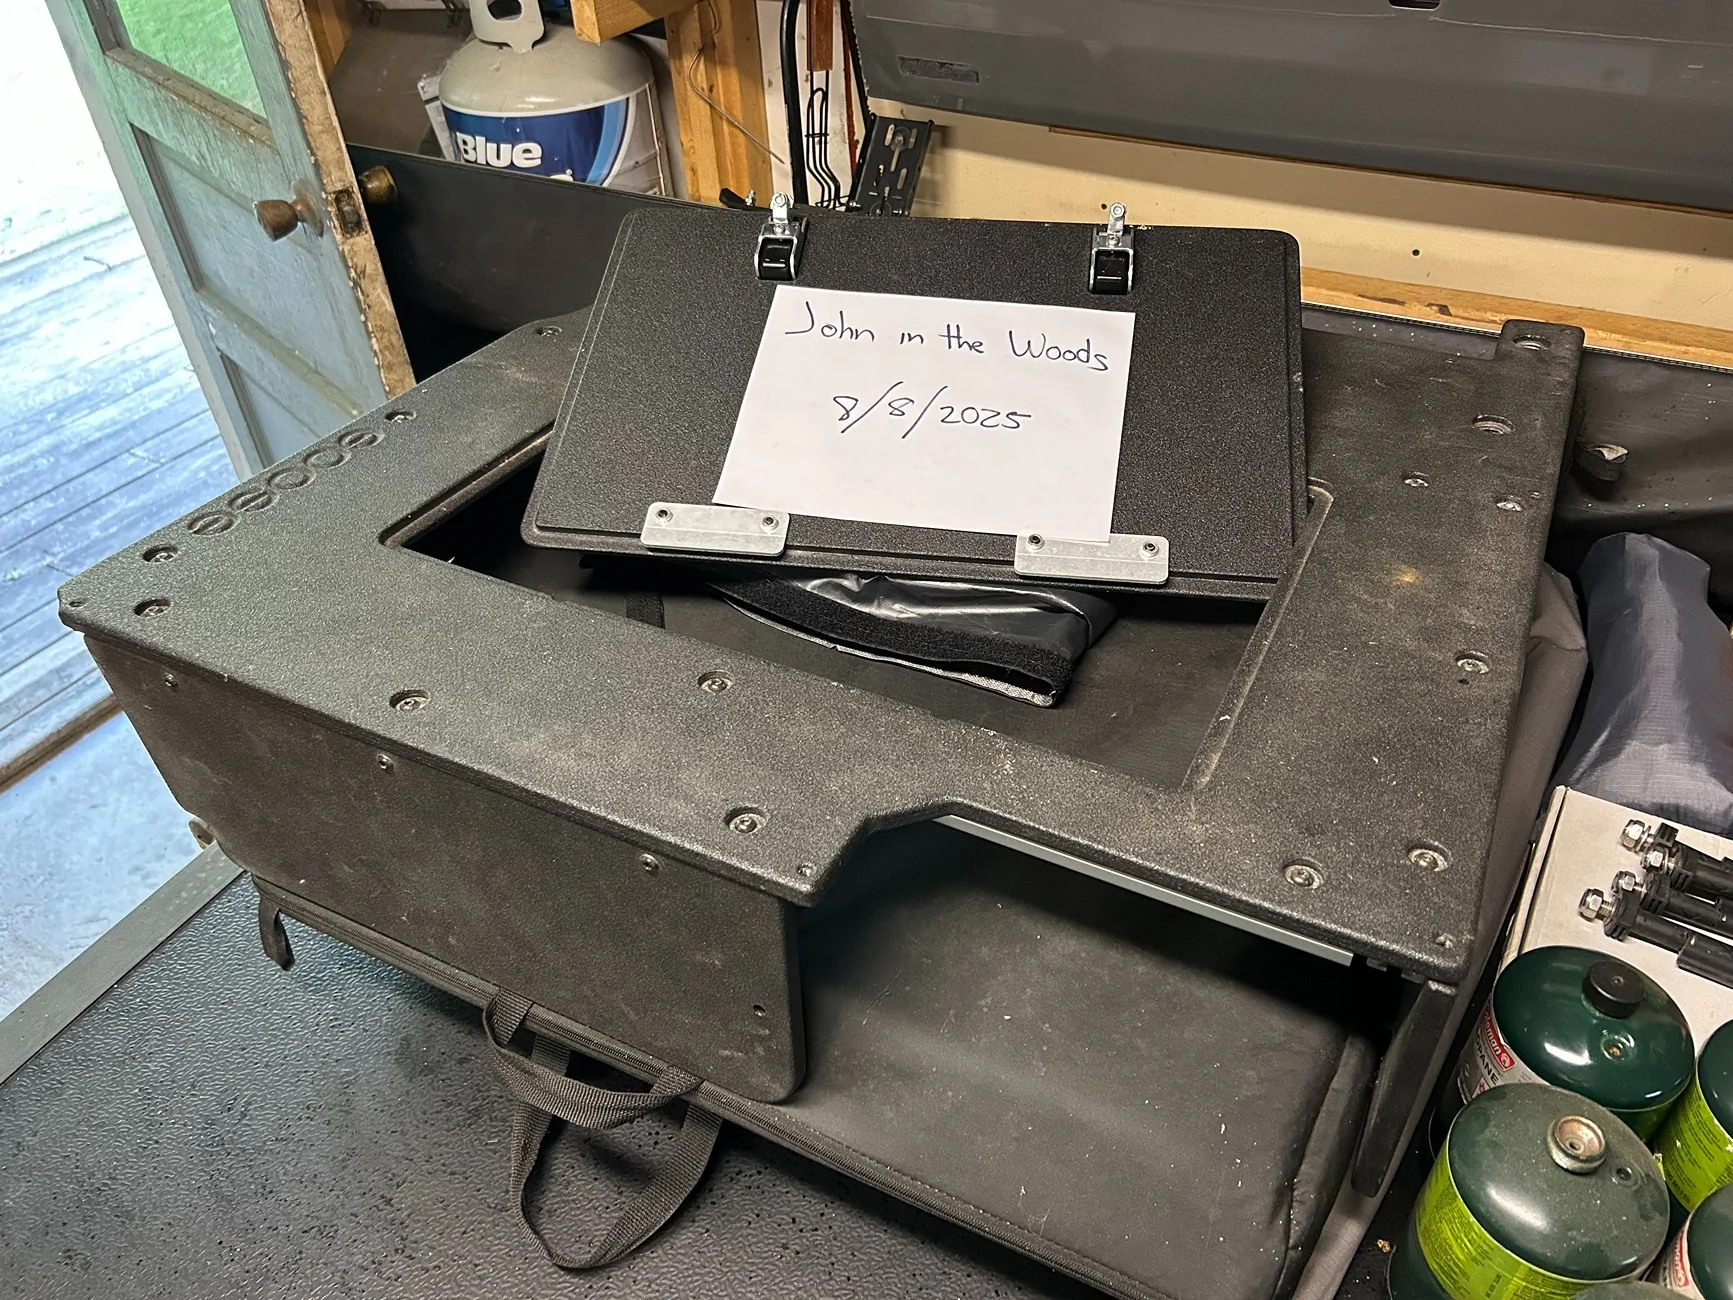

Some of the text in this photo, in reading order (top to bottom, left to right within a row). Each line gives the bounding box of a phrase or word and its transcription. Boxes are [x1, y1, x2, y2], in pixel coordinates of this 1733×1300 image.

[456, 131, 543, 168] Blue
[784, 300, 1109, 372] John in the Woods
[832, 380, 1033, 440] 8/8/2025
